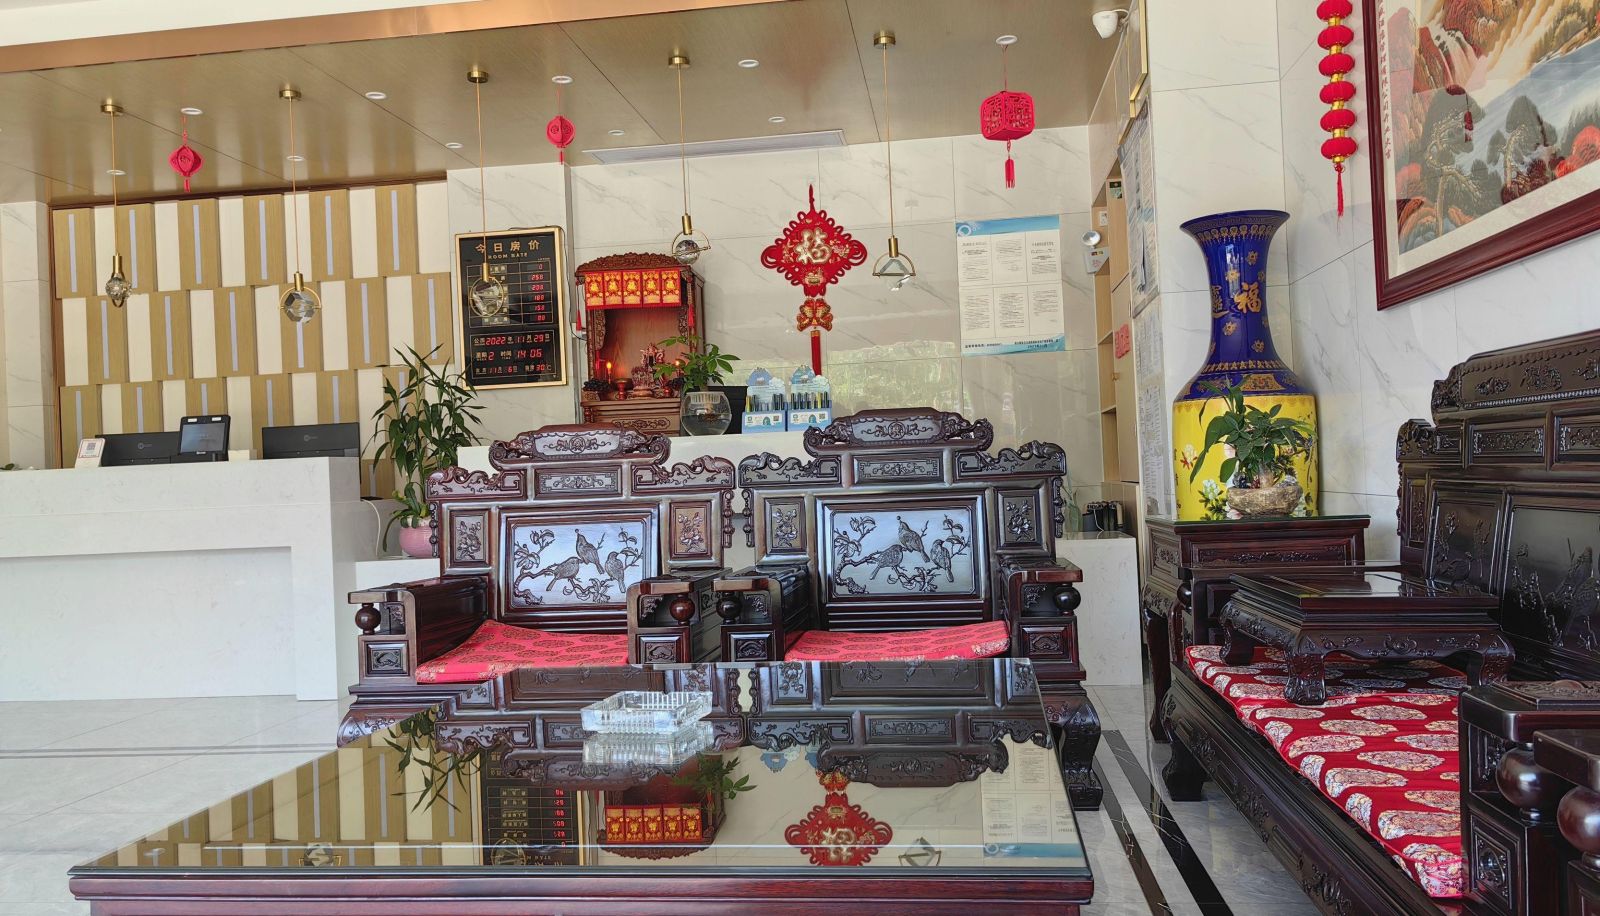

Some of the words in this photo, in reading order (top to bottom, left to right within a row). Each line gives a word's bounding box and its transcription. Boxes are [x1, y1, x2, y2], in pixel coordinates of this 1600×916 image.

[475, 240, 540, 253] 今日房价
[795, 228, 832, 265] 福
[1234, 282, 1262, 314] 福
